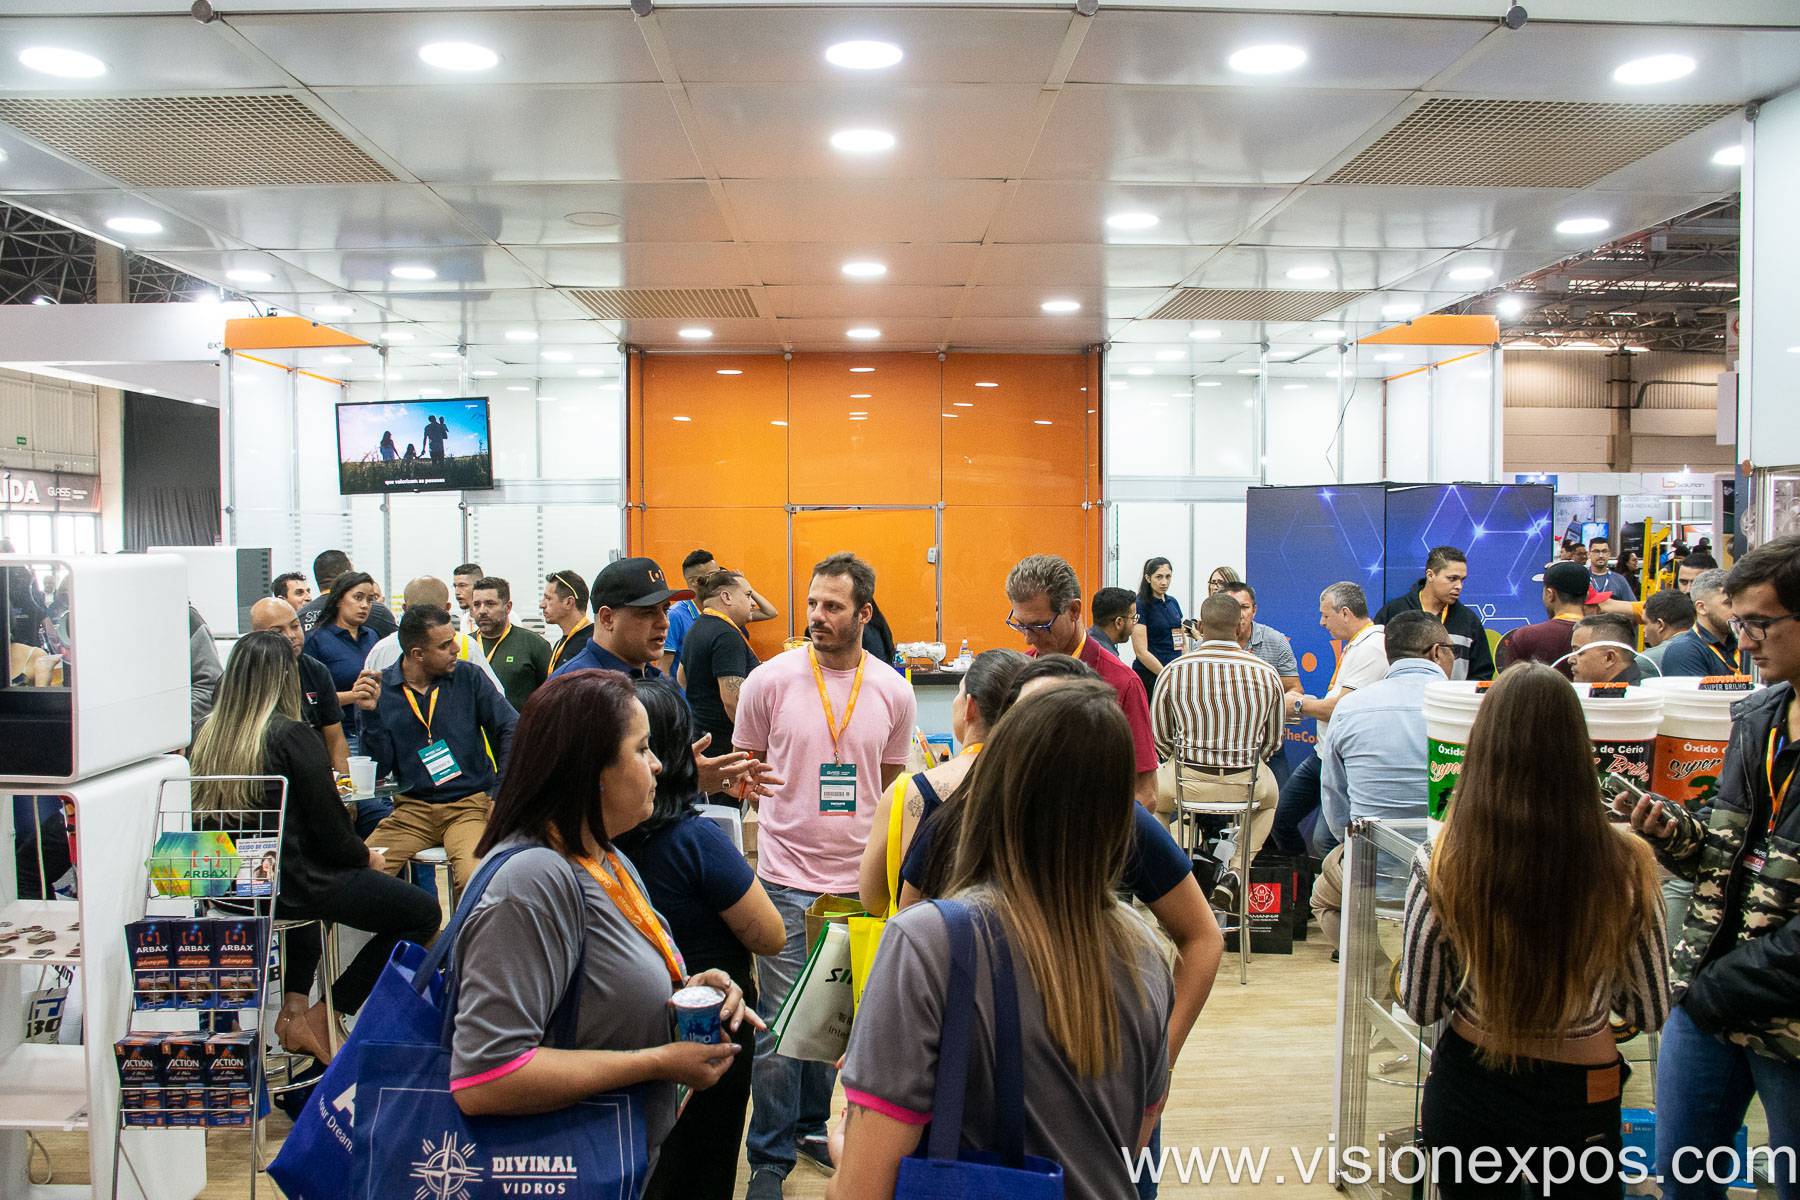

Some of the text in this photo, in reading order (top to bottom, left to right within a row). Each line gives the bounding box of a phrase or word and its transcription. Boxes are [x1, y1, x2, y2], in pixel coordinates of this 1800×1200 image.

[0, 471, 40, 504] ÍDA
[1600, 746, 1614, 754] de
[1617, 744, 1644, 754] Cério
[1683, 741, 1719, 754] Óxido
[1667, 758, 1722, 780] Super
[183, 869, 229, 879] ARBAX
[136, 944, 169, 954] ARBAX
[121, 1059, 154, 1070] ACTION
[166, 1059, 200, 1070] ACTION
[210, 1058, 244, 1070] ACTION
[491, 1155, 577, 1173] DIVINAL
[502, 1183, 567, 1195] VIDROS
